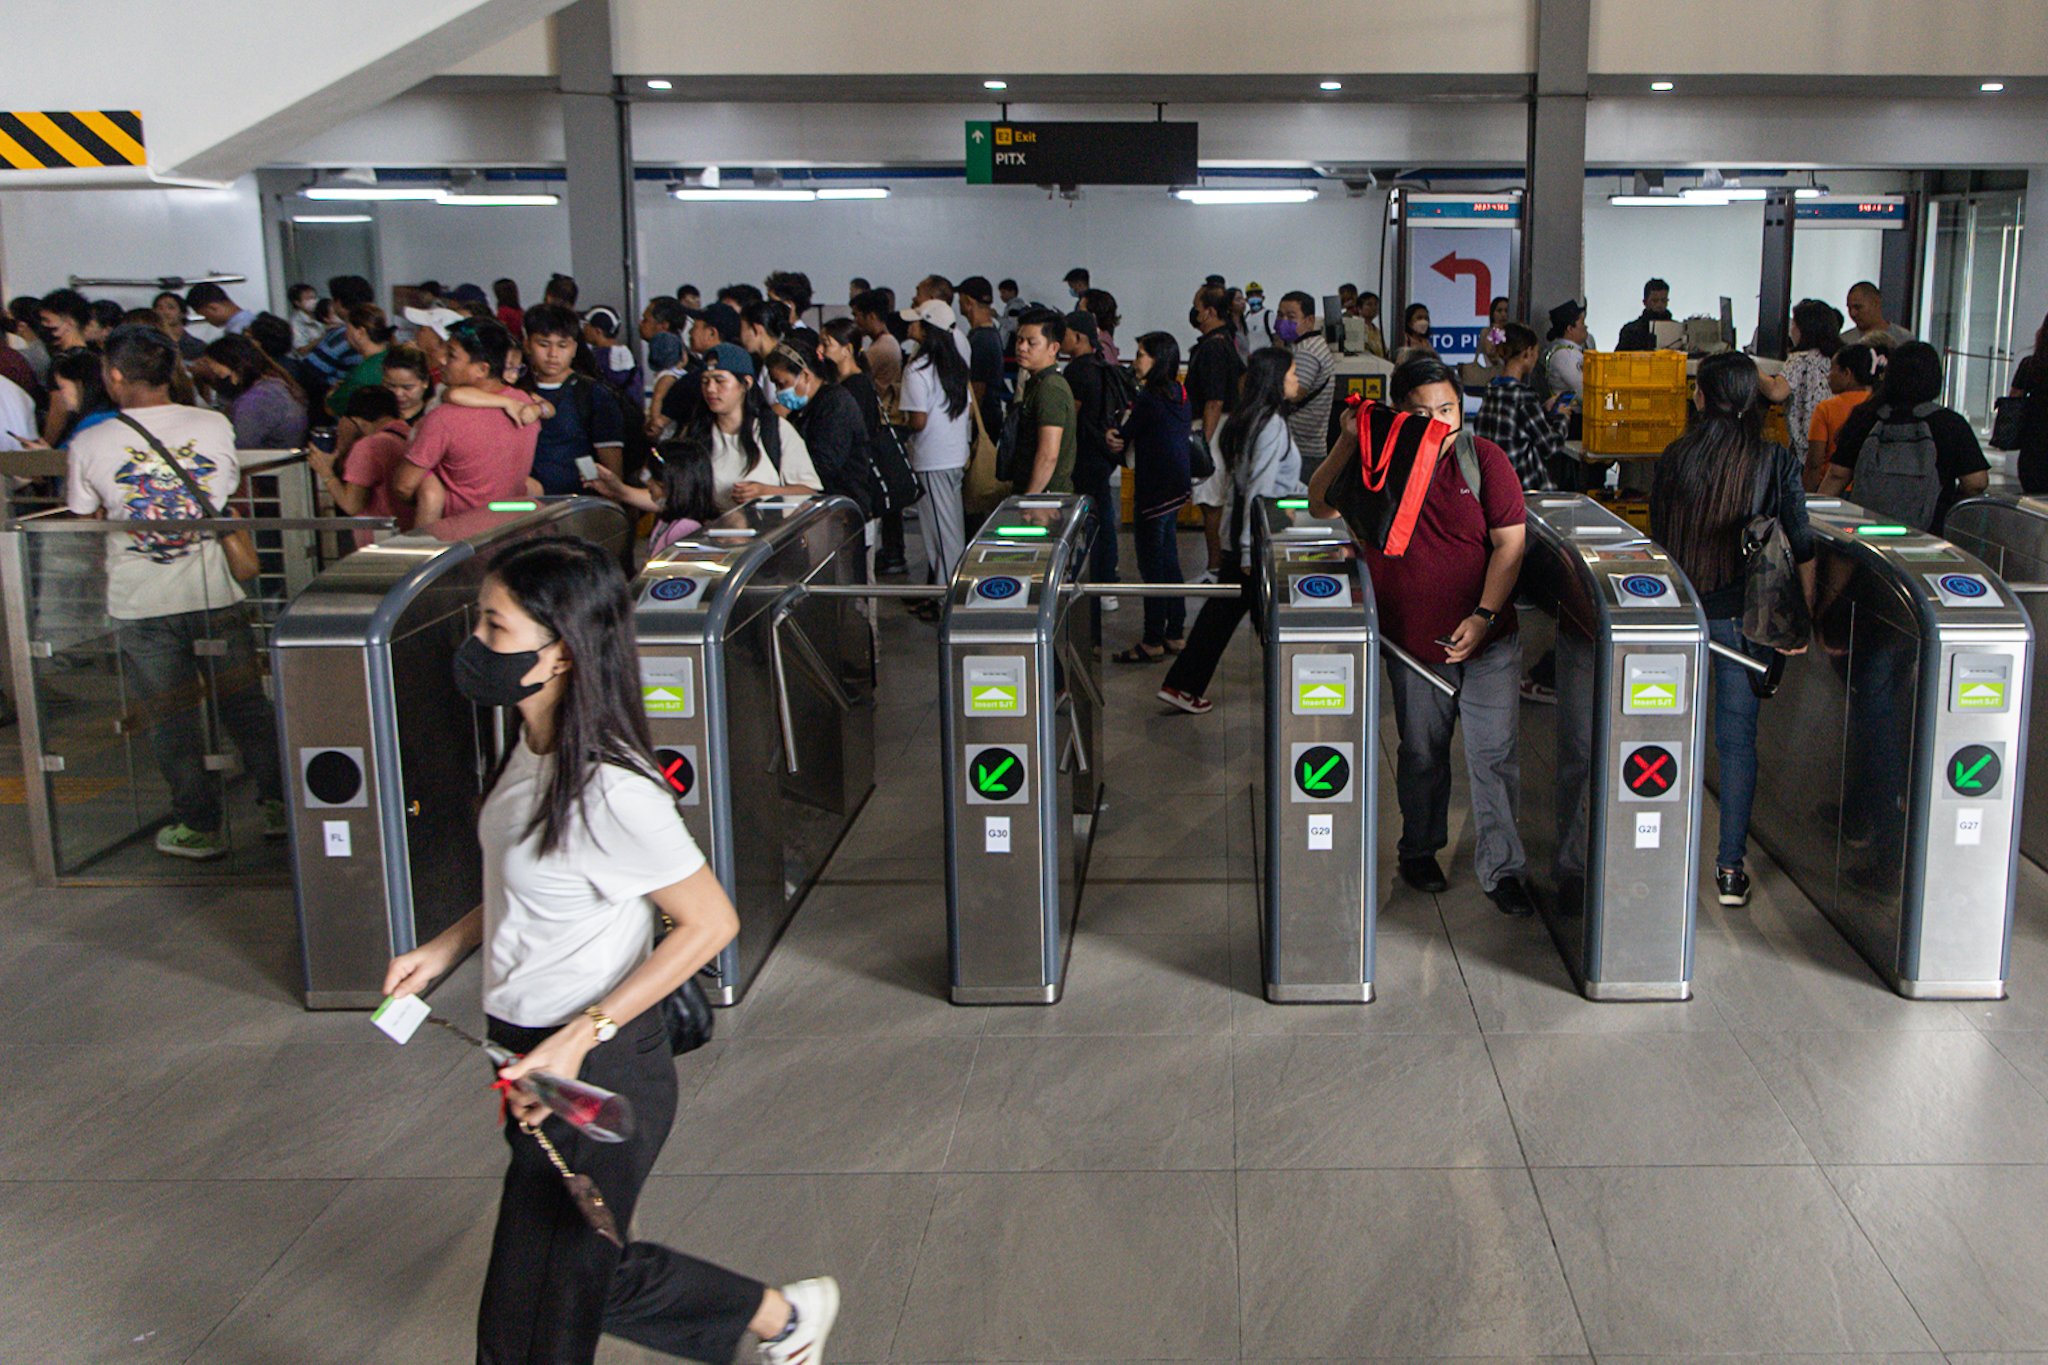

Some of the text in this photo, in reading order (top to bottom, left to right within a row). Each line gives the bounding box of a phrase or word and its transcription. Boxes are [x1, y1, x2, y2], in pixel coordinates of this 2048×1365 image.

[1015, 130, 1037, 143] Exit
[995, 152, 1026, 165] PITX
[1431, 333, 1480, 348] TO PI
[974, 701, 997, 709] Insert
[1638, 825, 1657, 833] G28
[1960, 821, 1979, 830] G27
[989, 829, 1008, 838] G30
[1311, 826, 1331, 835] G29
